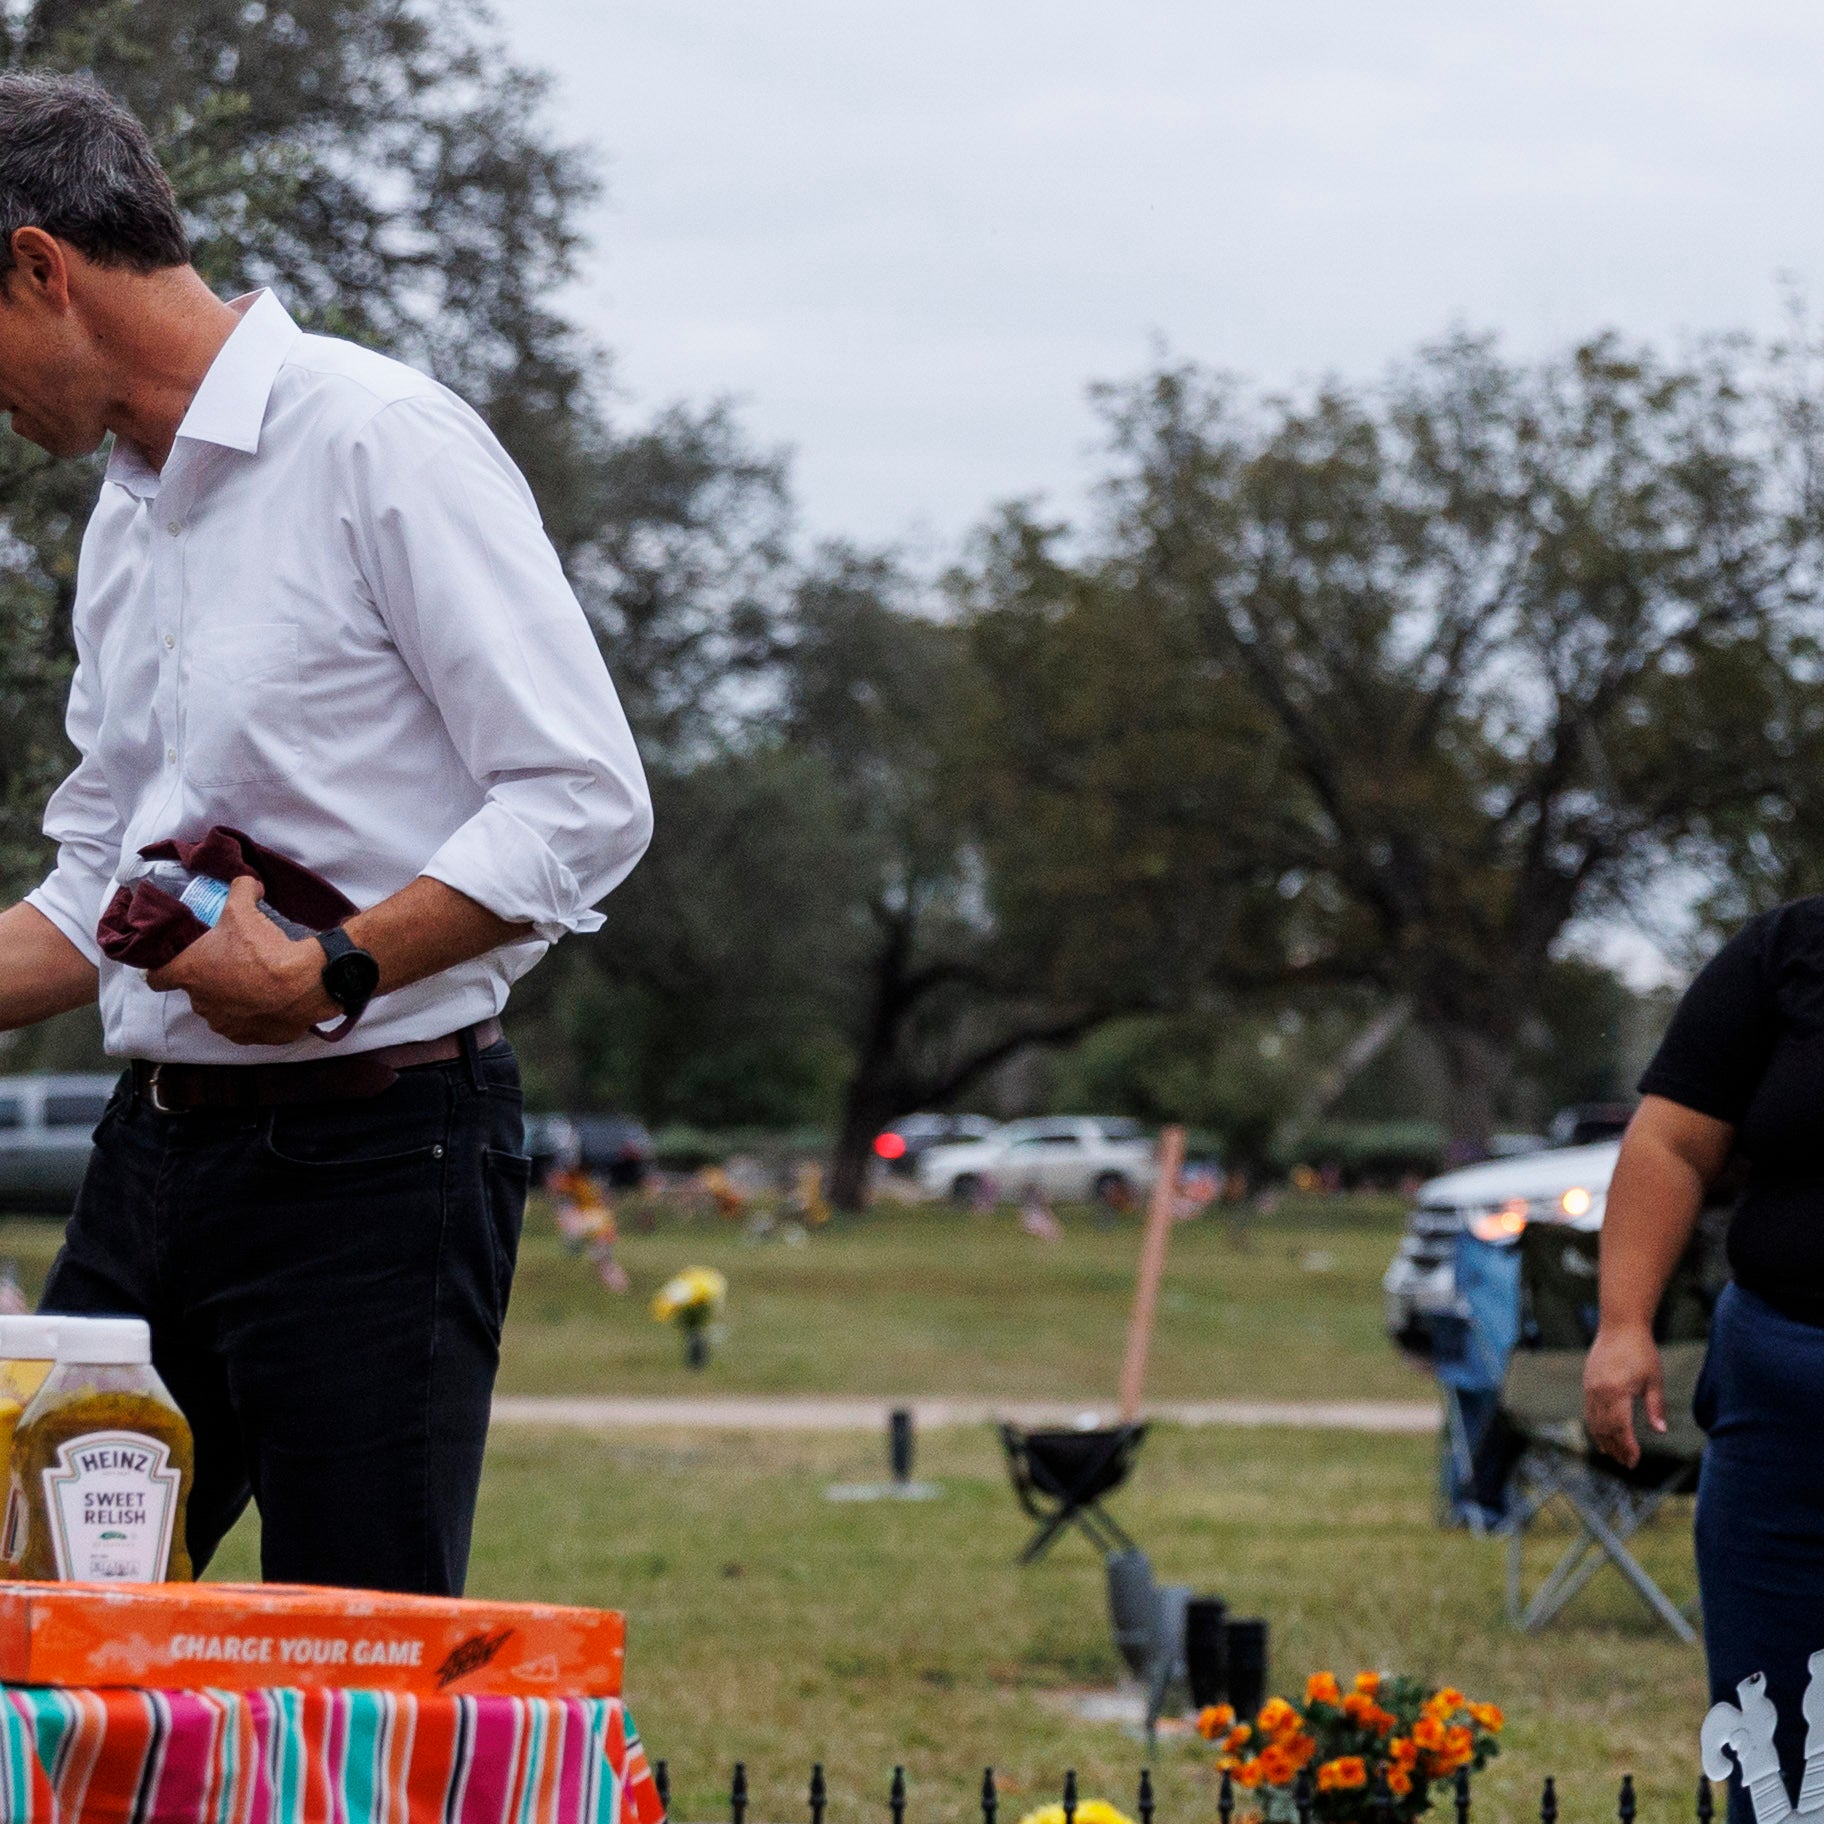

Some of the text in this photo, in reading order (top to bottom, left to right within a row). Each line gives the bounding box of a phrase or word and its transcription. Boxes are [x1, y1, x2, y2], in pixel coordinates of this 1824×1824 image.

[80, 1450, 149, 1473] HEINZ
[84, 1492, 146, 1508] SWEET
[84, 1510, 147, 1525] RELISH
[170, 1633, 275, 1662] CHARGE
[279, 1637, 350, 1664] YOUR
[352, 1639, 425, 1667] GAME
